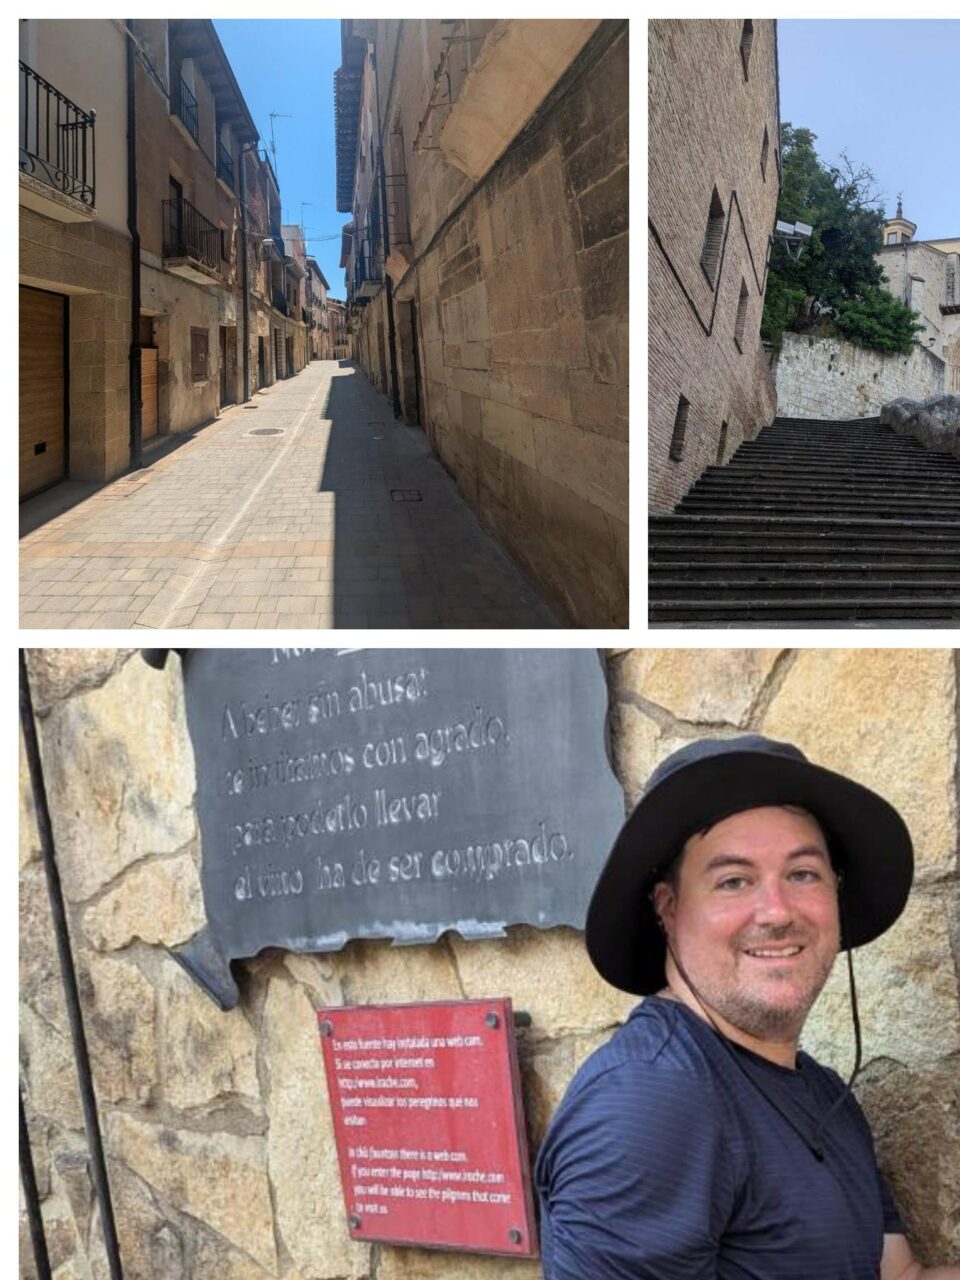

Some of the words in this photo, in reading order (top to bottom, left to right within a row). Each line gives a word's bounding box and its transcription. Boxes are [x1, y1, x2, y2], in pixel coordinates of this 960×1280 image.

[363, 738, 407, 769] con
[375, 788, 443, 826] llevar
[235, 864, 252, 900] el
[316, 855, 346, 890] ha
[352, 849, 381, 886] de
[389, 852, 423, 882] ser
